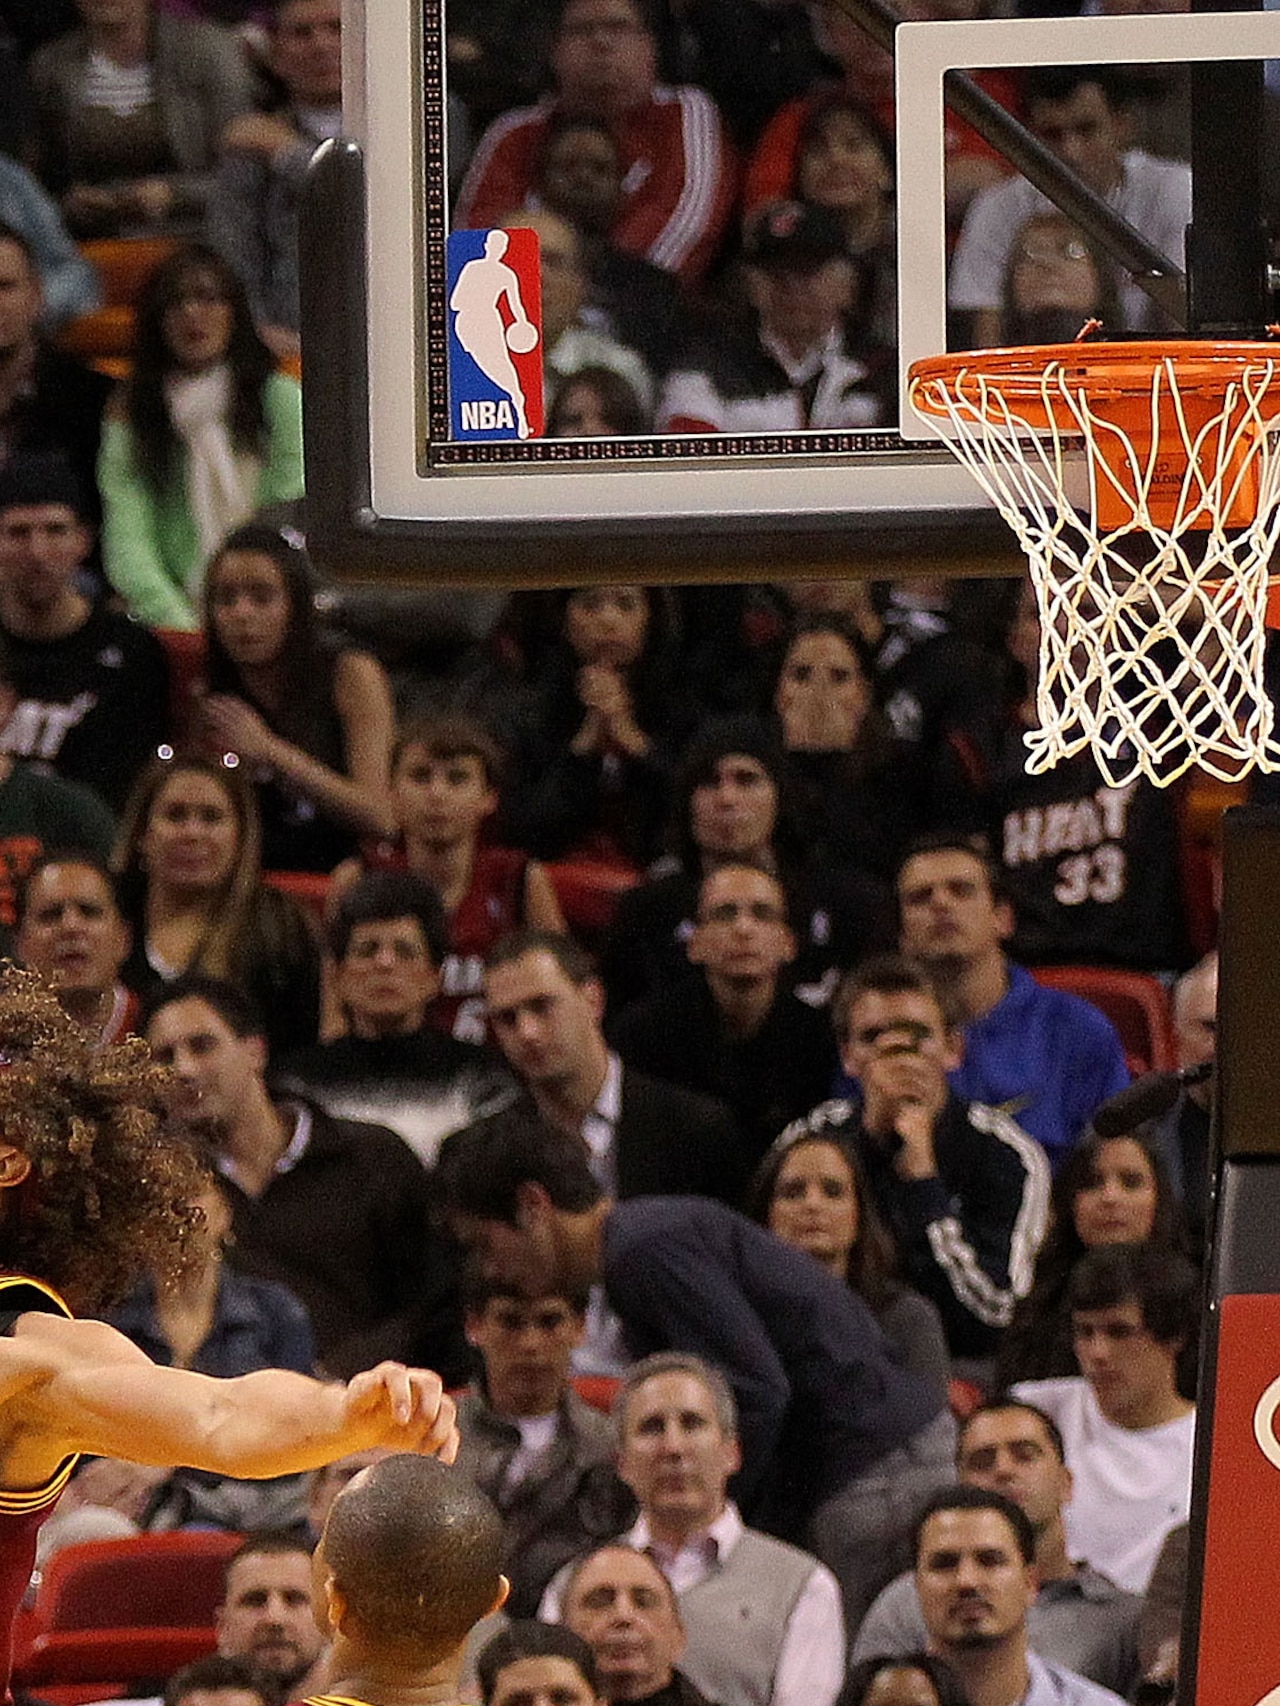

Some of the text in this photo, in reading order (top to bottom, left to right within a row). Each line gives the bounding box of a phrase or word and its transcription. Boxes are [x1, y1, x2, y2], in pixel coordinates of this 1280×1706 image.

[460, 400, 515, 431] NBA
[1002, 783, 1139, 867] HEAT
[1053, 843, 1125, 906] 33
